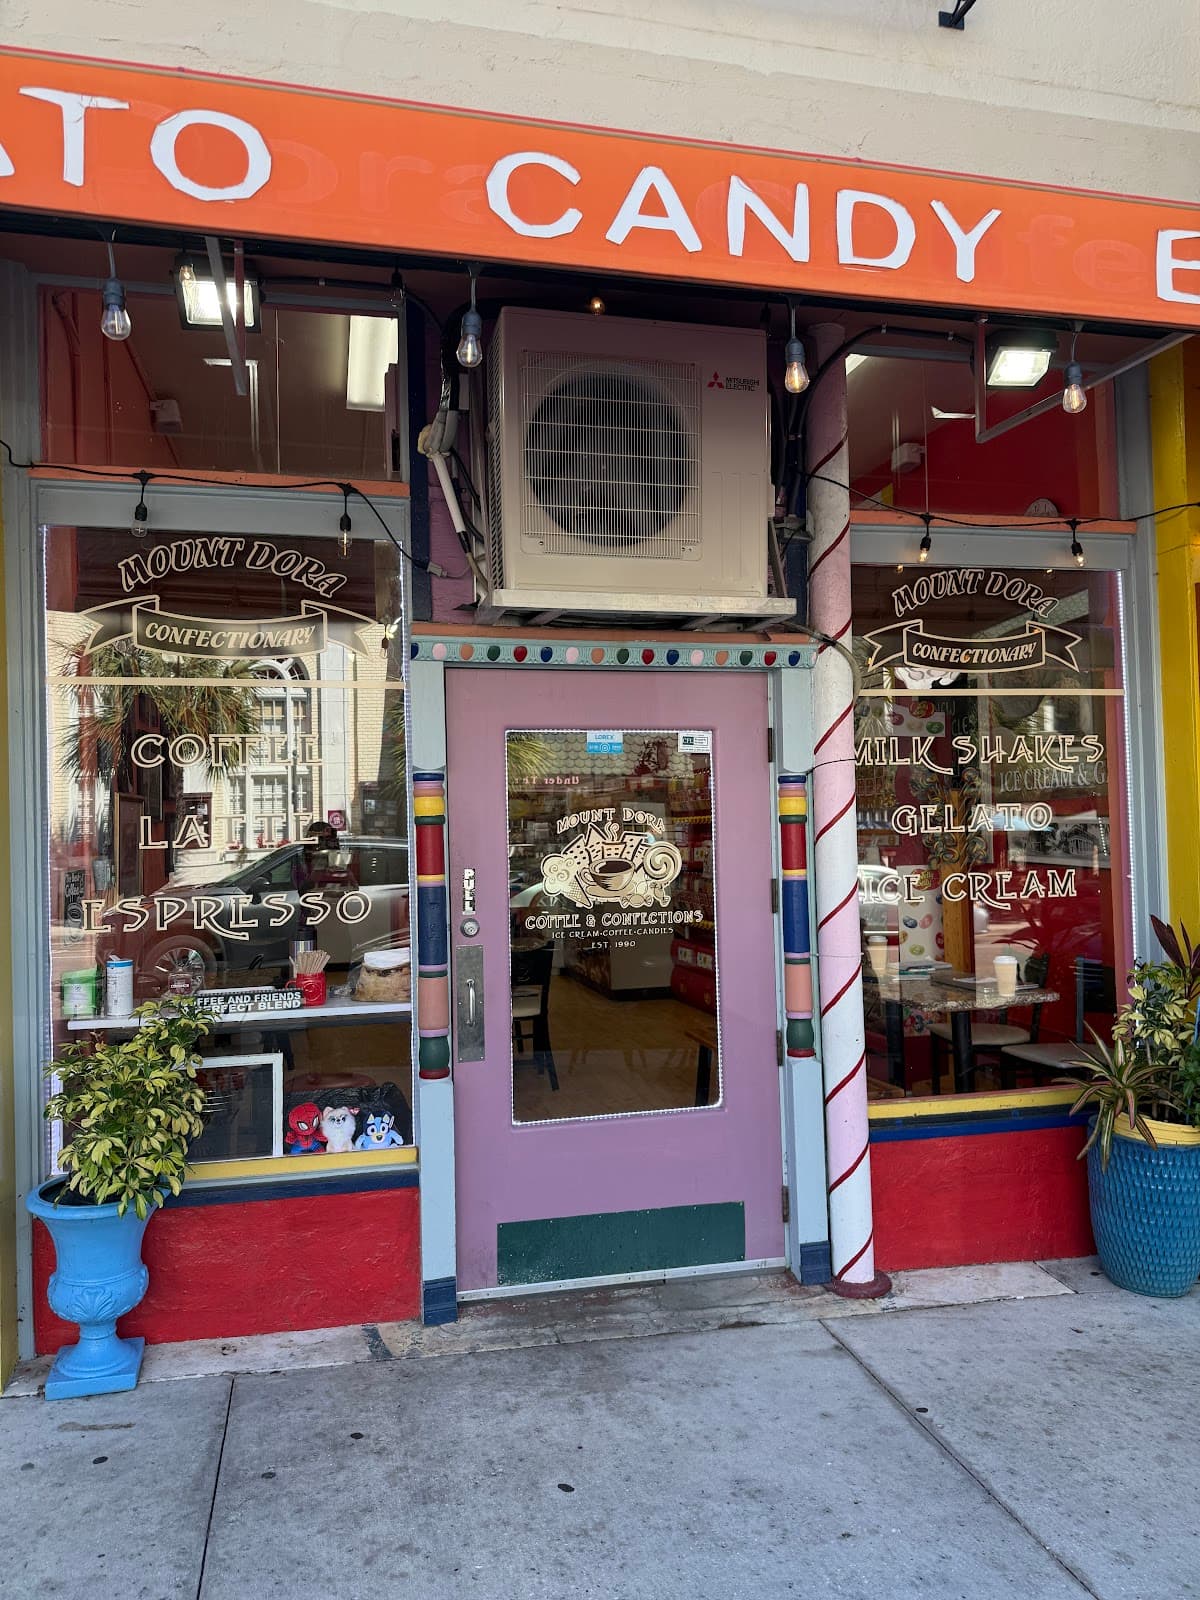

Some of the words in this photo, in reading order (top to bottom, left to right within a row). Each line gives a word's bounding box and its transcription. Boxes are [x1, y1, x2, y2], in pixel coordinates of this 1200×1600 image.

[0, 87, 272, 201] TO
[486, 152, 1002, 283] CANDY
[118, 537, 246, 593] MOUNT
[246, 541, 348, 598] DORA
[892, 569, 984, 617] MOUNT
[985, 572, 1059, 618] DORA
[145, 621, 317, 649] CONFECTIONARY
[912, 641, 1037, 664] CONFECTIONARY
[130, 733, 324, 768] COFFEE
[854, 736, 954, 775] MILK
[952, 735, 1105, 773] SHAKES
[139, 812, 319, 850] LATTE
[556, 808, 616, 834] MOUNT
[622, 808, 666, 834] DORA
[891, 802, 1053, 836] GELATO
[862, 874, 925, 905] ICE
[942, 869, 1077, 910] CREAM
[81, 890, 372, 941] ESPRESSO
[525, 914, 582, 929] COFFEE
[585, 914, 596, 928] &
[601, 910, 704, 927] CONFECTIONS
[552, 931, 566, 939] ICE
[615, 940, 636, 948] 1990
[195, 1002, 255, 1014] ERFECT
[258, 1000, 301, 1011] BLEND
[196, 996, 225, 1006] FFEE
[228, 994, 251, 1004] AND
[254, 991, 301, 1003] FRIENDS
